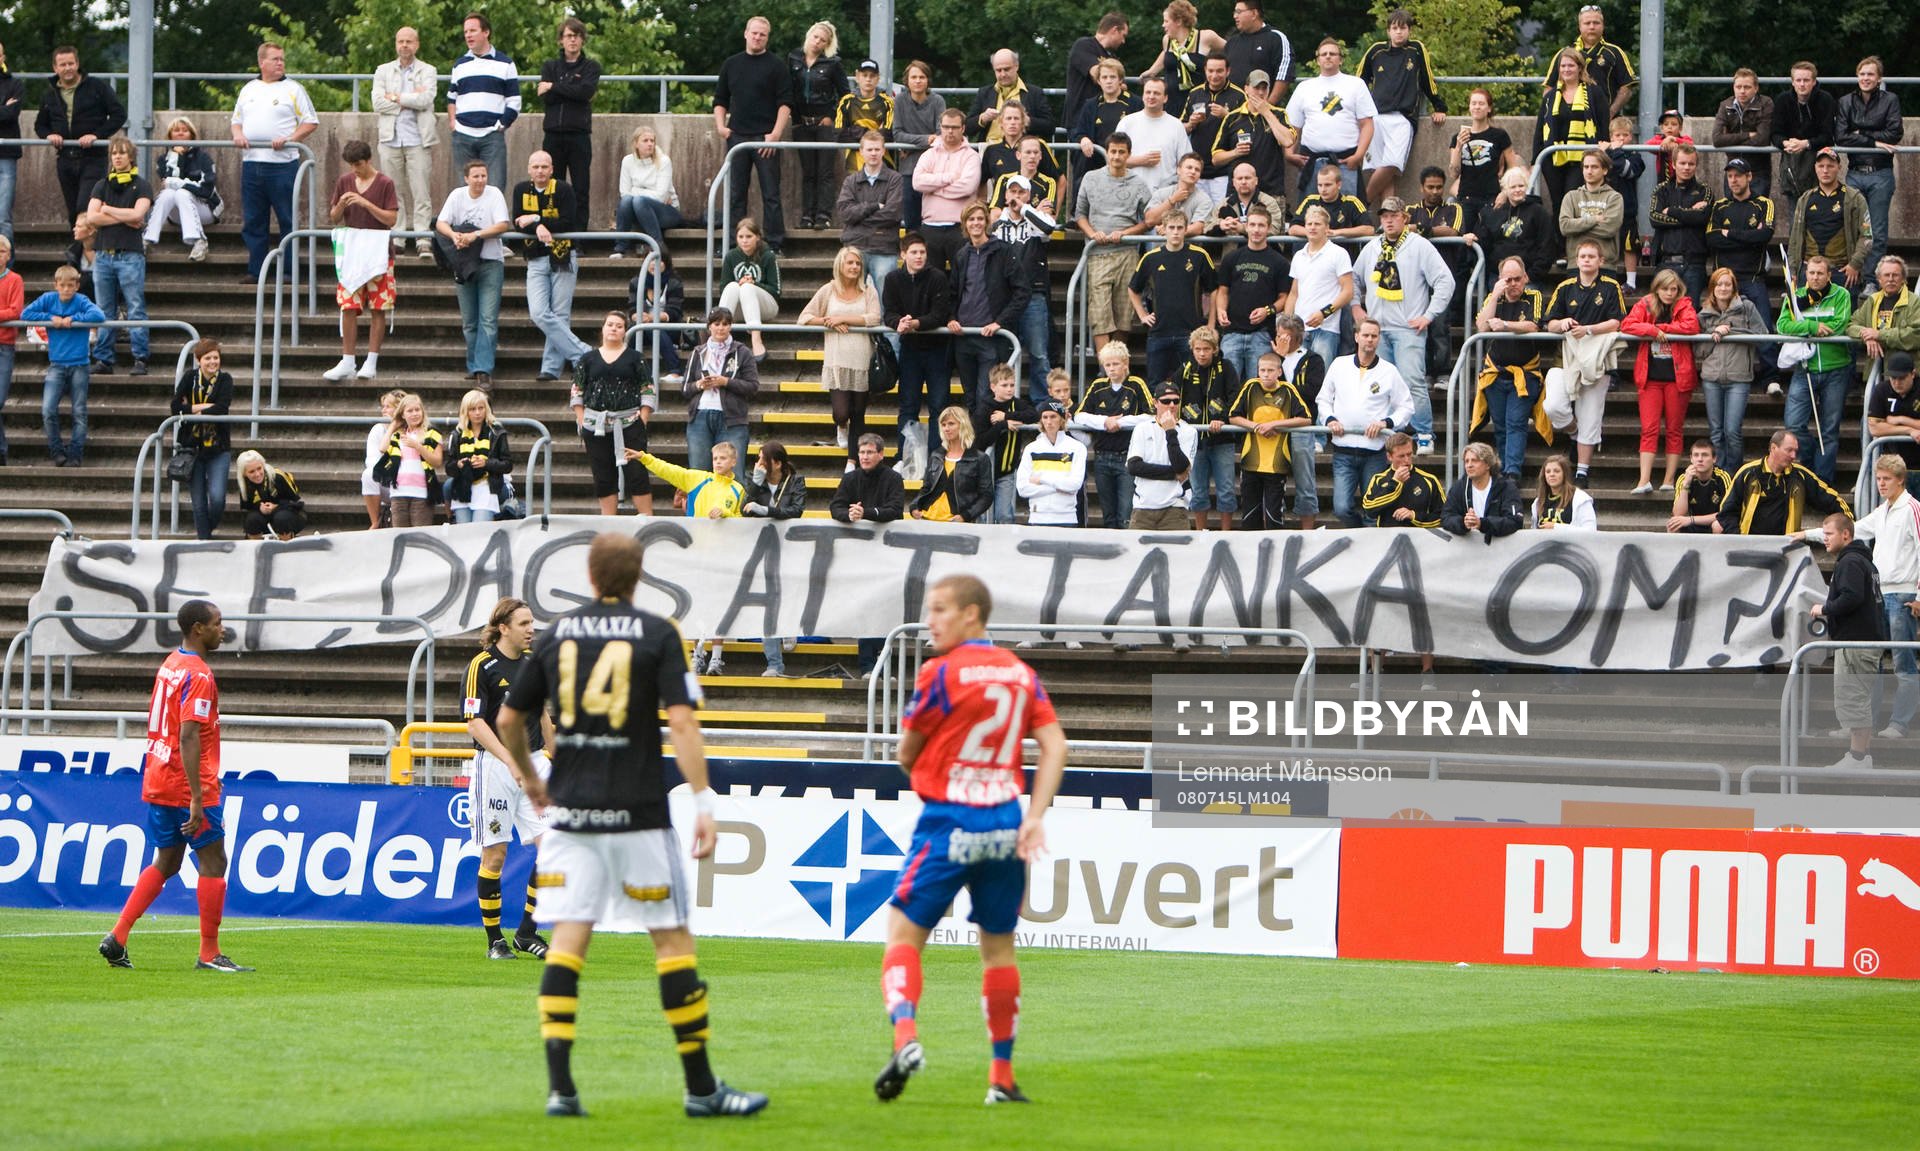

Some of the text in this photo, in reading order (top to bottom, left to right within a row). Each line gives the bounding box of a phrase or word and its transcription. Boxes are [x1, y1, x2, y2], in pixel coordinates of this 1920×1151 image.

[1887, 397, 1897, 412] 7
[376, 521, 696, 635] DAGS
[715, 522, 980, 637] ATT
[1016, 533, 1434, 654] TÄNKA
[554, 616, 644, 639] PANAXIA
[558, 639, 633, 729] 14
[958, 685, 1028, 765] 21
[488, 798, 508, 811] NGA
[1503, 843, 1848, 969] PUMA
[933, 928, 959, 944] EN
